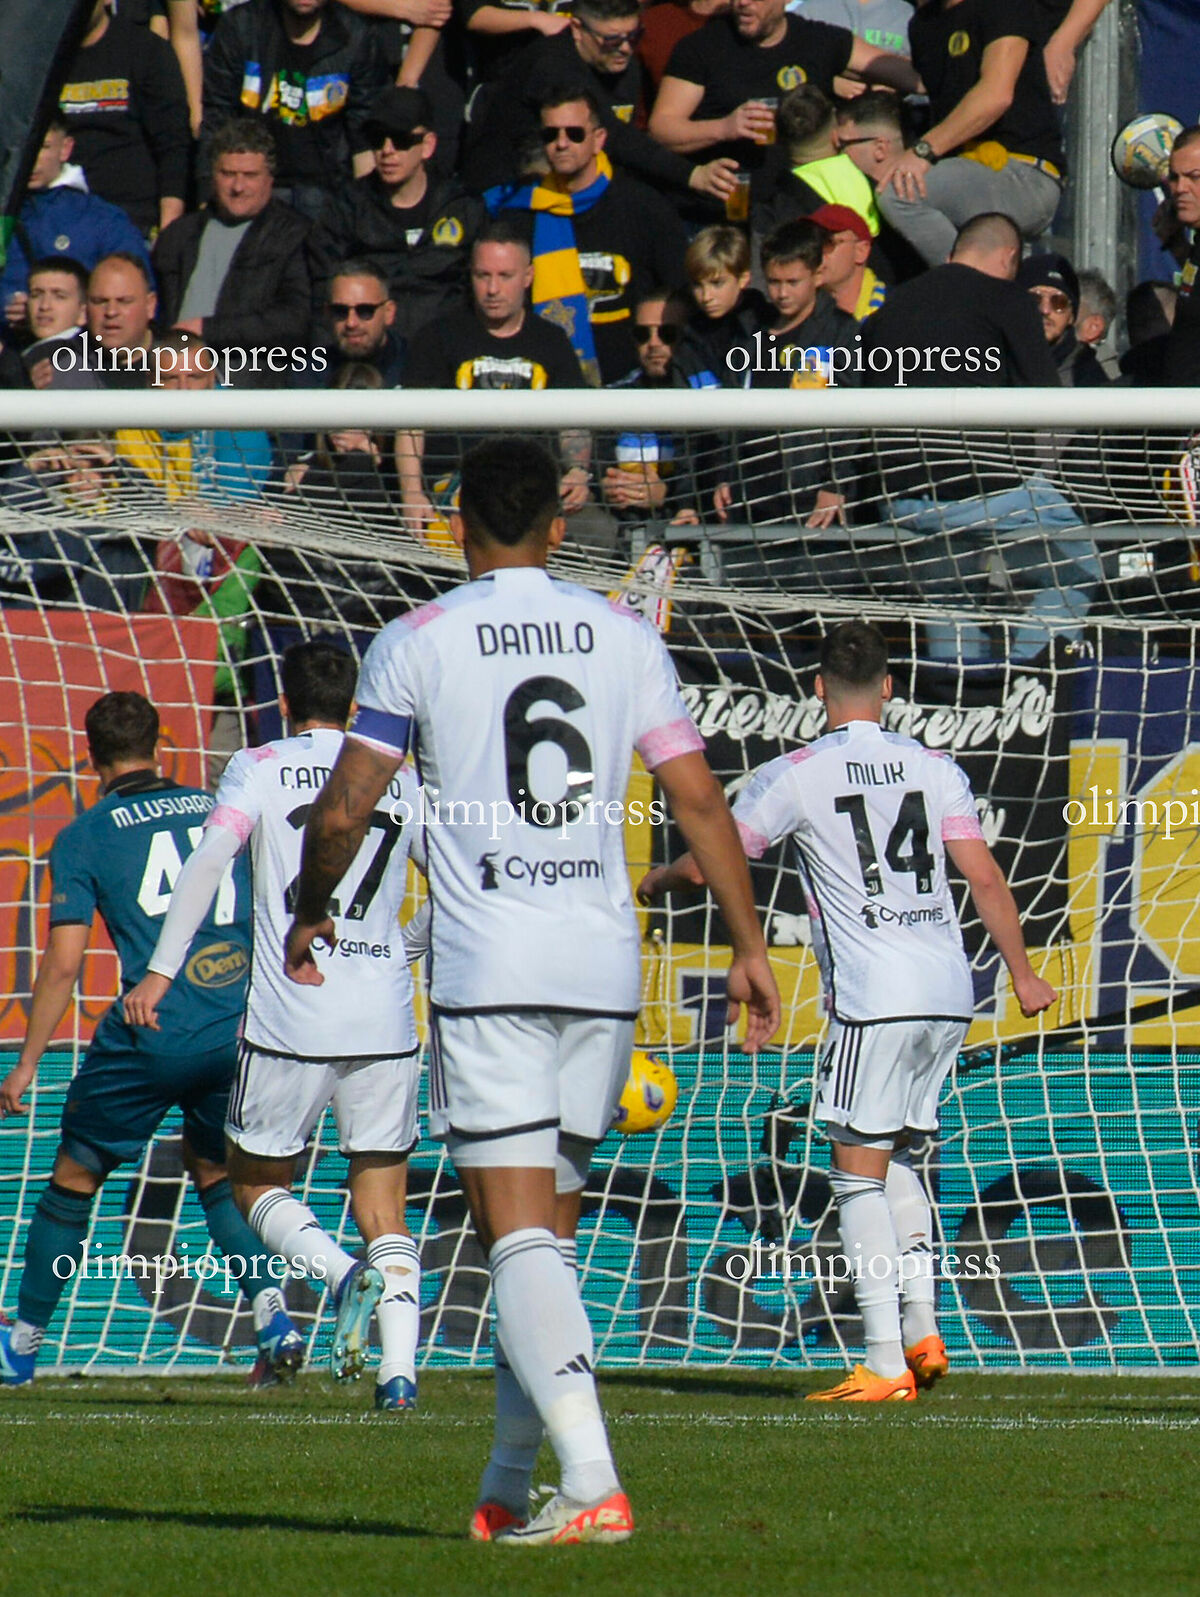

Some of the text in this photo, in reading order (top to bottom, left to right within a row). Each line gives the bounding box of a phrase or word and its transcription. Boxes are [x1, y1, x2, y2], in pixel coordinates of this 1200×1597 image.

[476, 621, 594, 656] DANILO
[503, 675, 594, 829] 6
[846, 762, 905, 786] MILIK
[834, 791, 934, 897] 14
[195, 947, 247, 982] Dem
